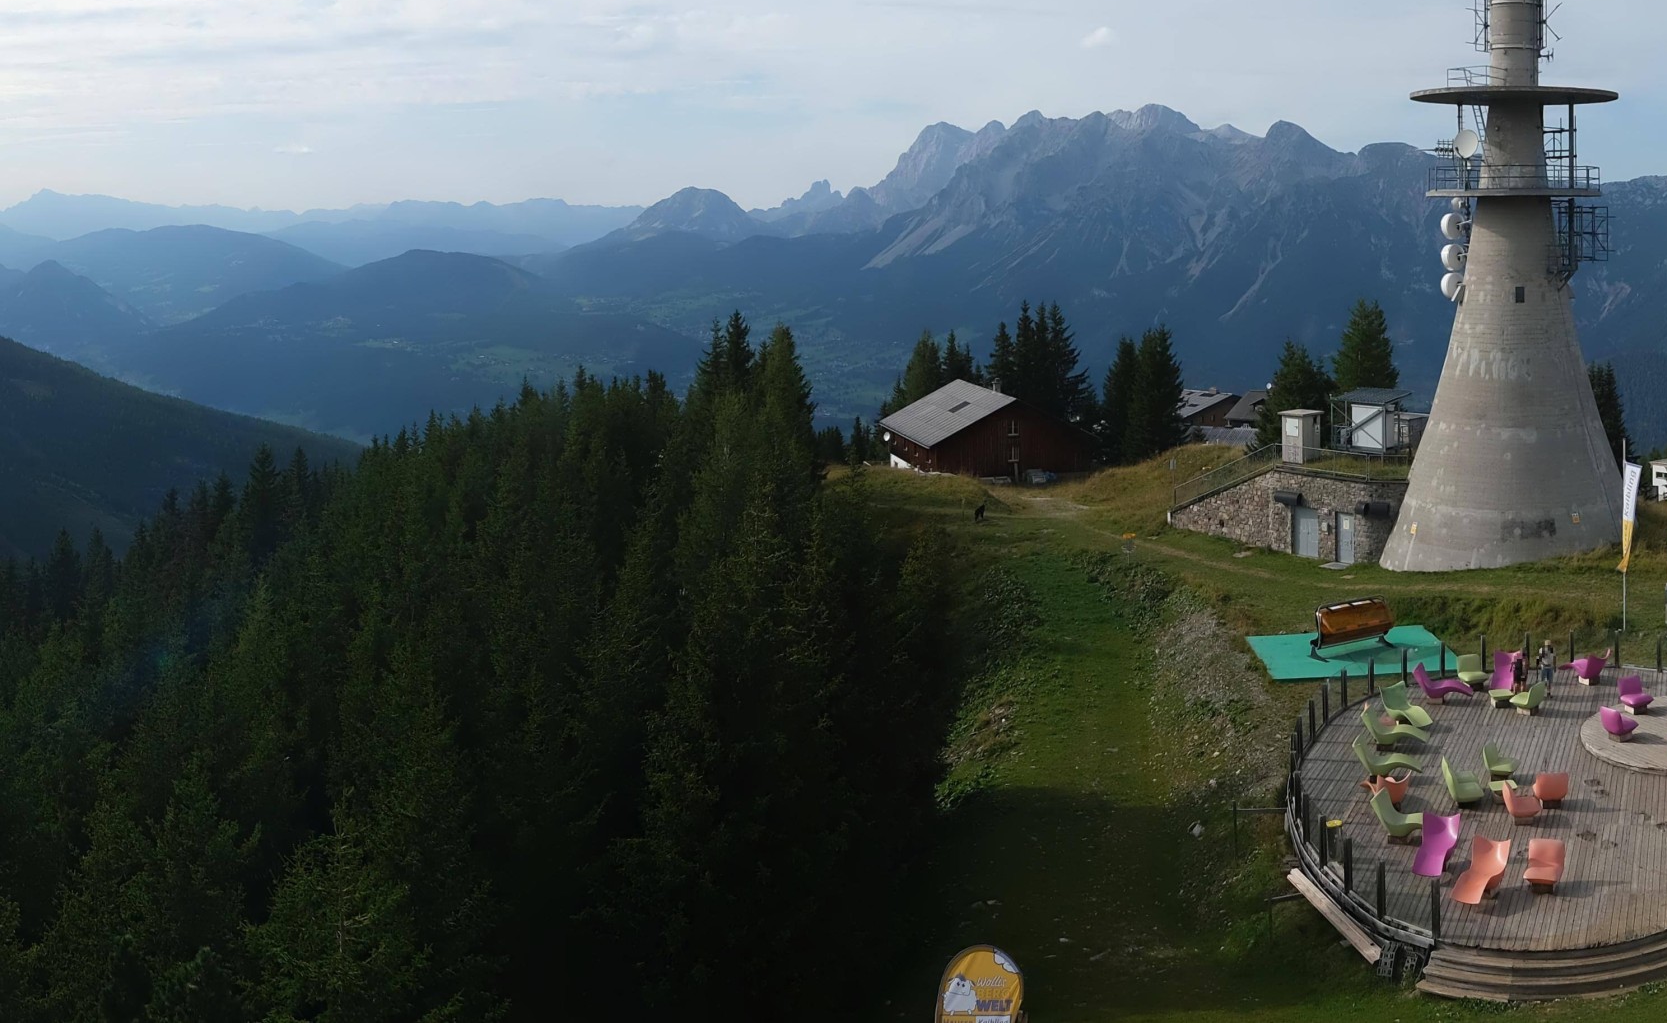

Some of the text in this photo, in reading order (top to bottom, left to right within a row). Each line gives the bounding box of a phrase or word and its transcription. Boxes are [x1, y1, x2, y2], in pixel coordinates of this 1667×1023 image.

[1624, 470, 1637, 517] Kaibling
[977, 988, 1012, 998] BERG
[976, 999, 1013, 1012] WELT
